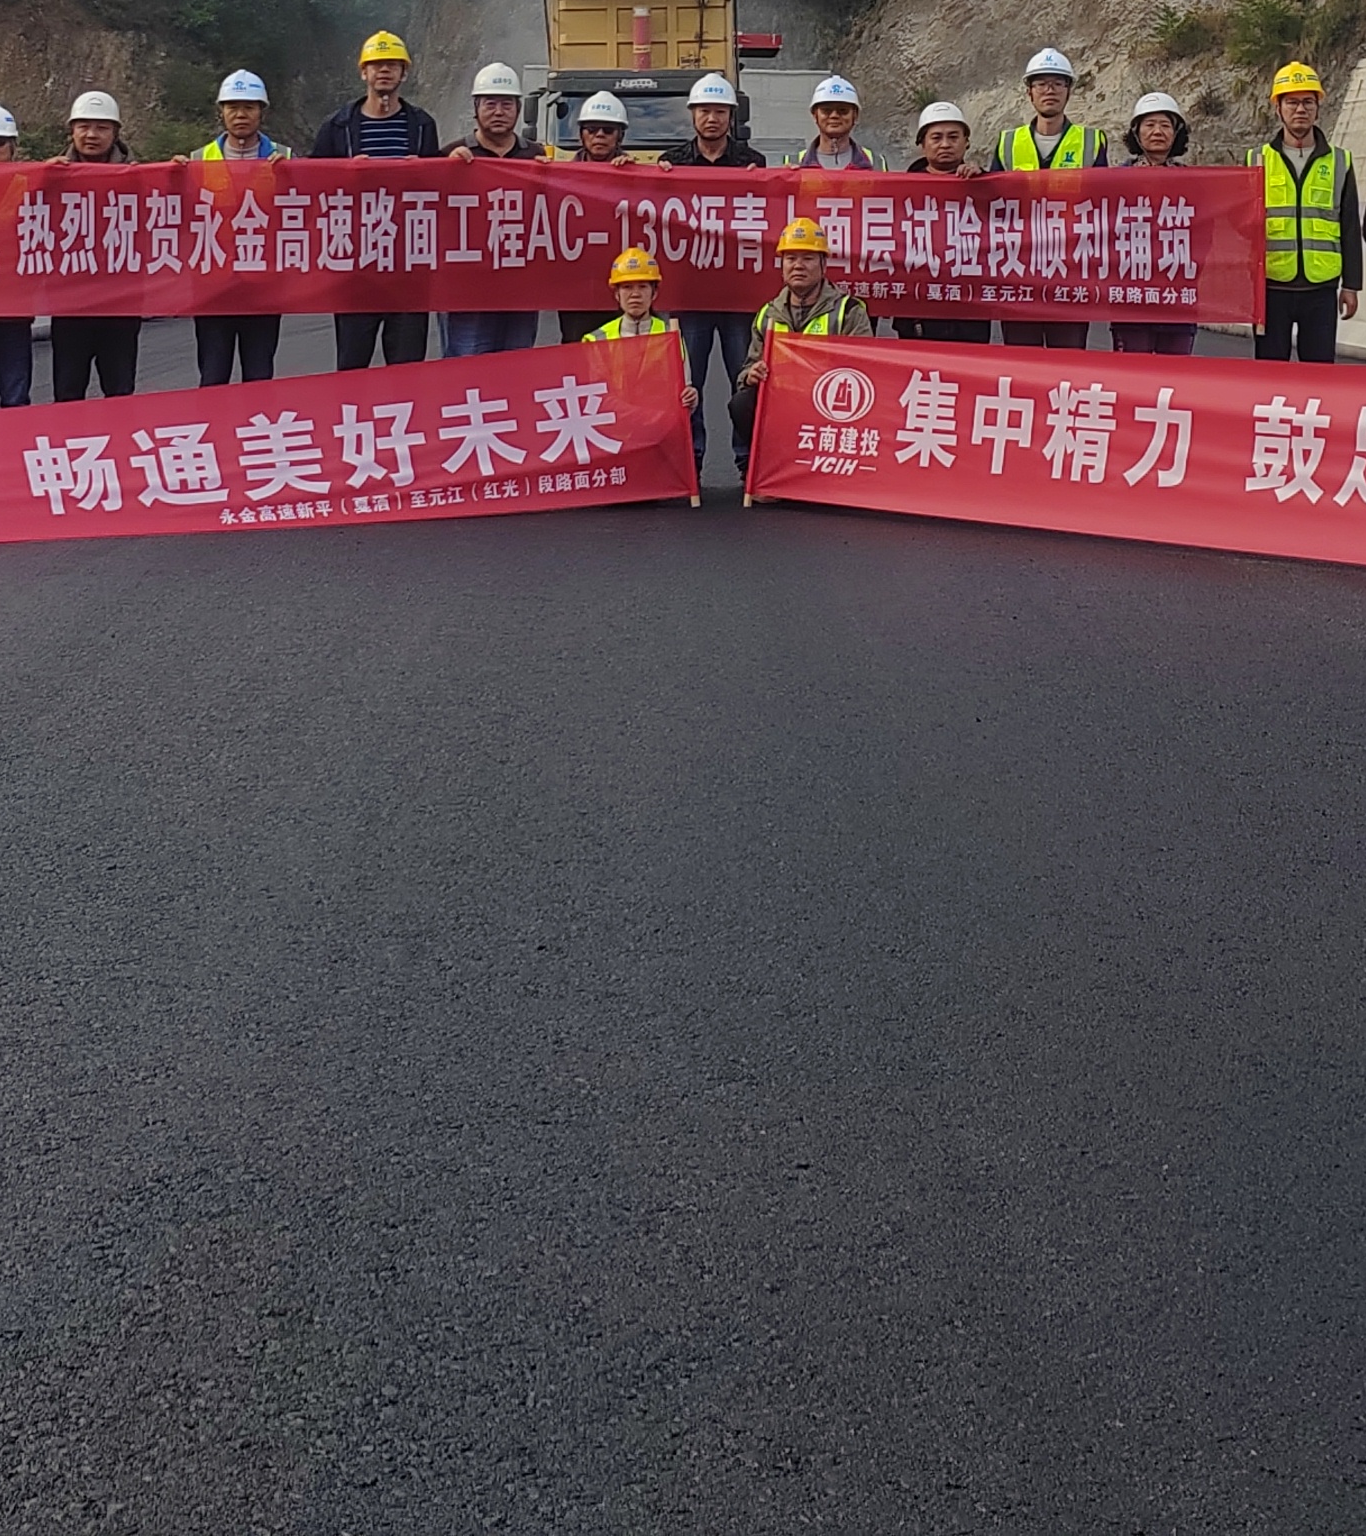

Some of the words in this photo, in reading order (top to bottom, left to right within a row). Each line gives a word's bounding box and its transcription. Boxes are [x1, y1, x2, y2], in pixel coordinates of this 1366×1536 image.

[23, 375, 624, 515] 畅通美好未来
[796, 423, 881, 457] 云南建投
[810, 455, 858, 476] YCIH
[894, 369, 1193, 487] 集中精力
